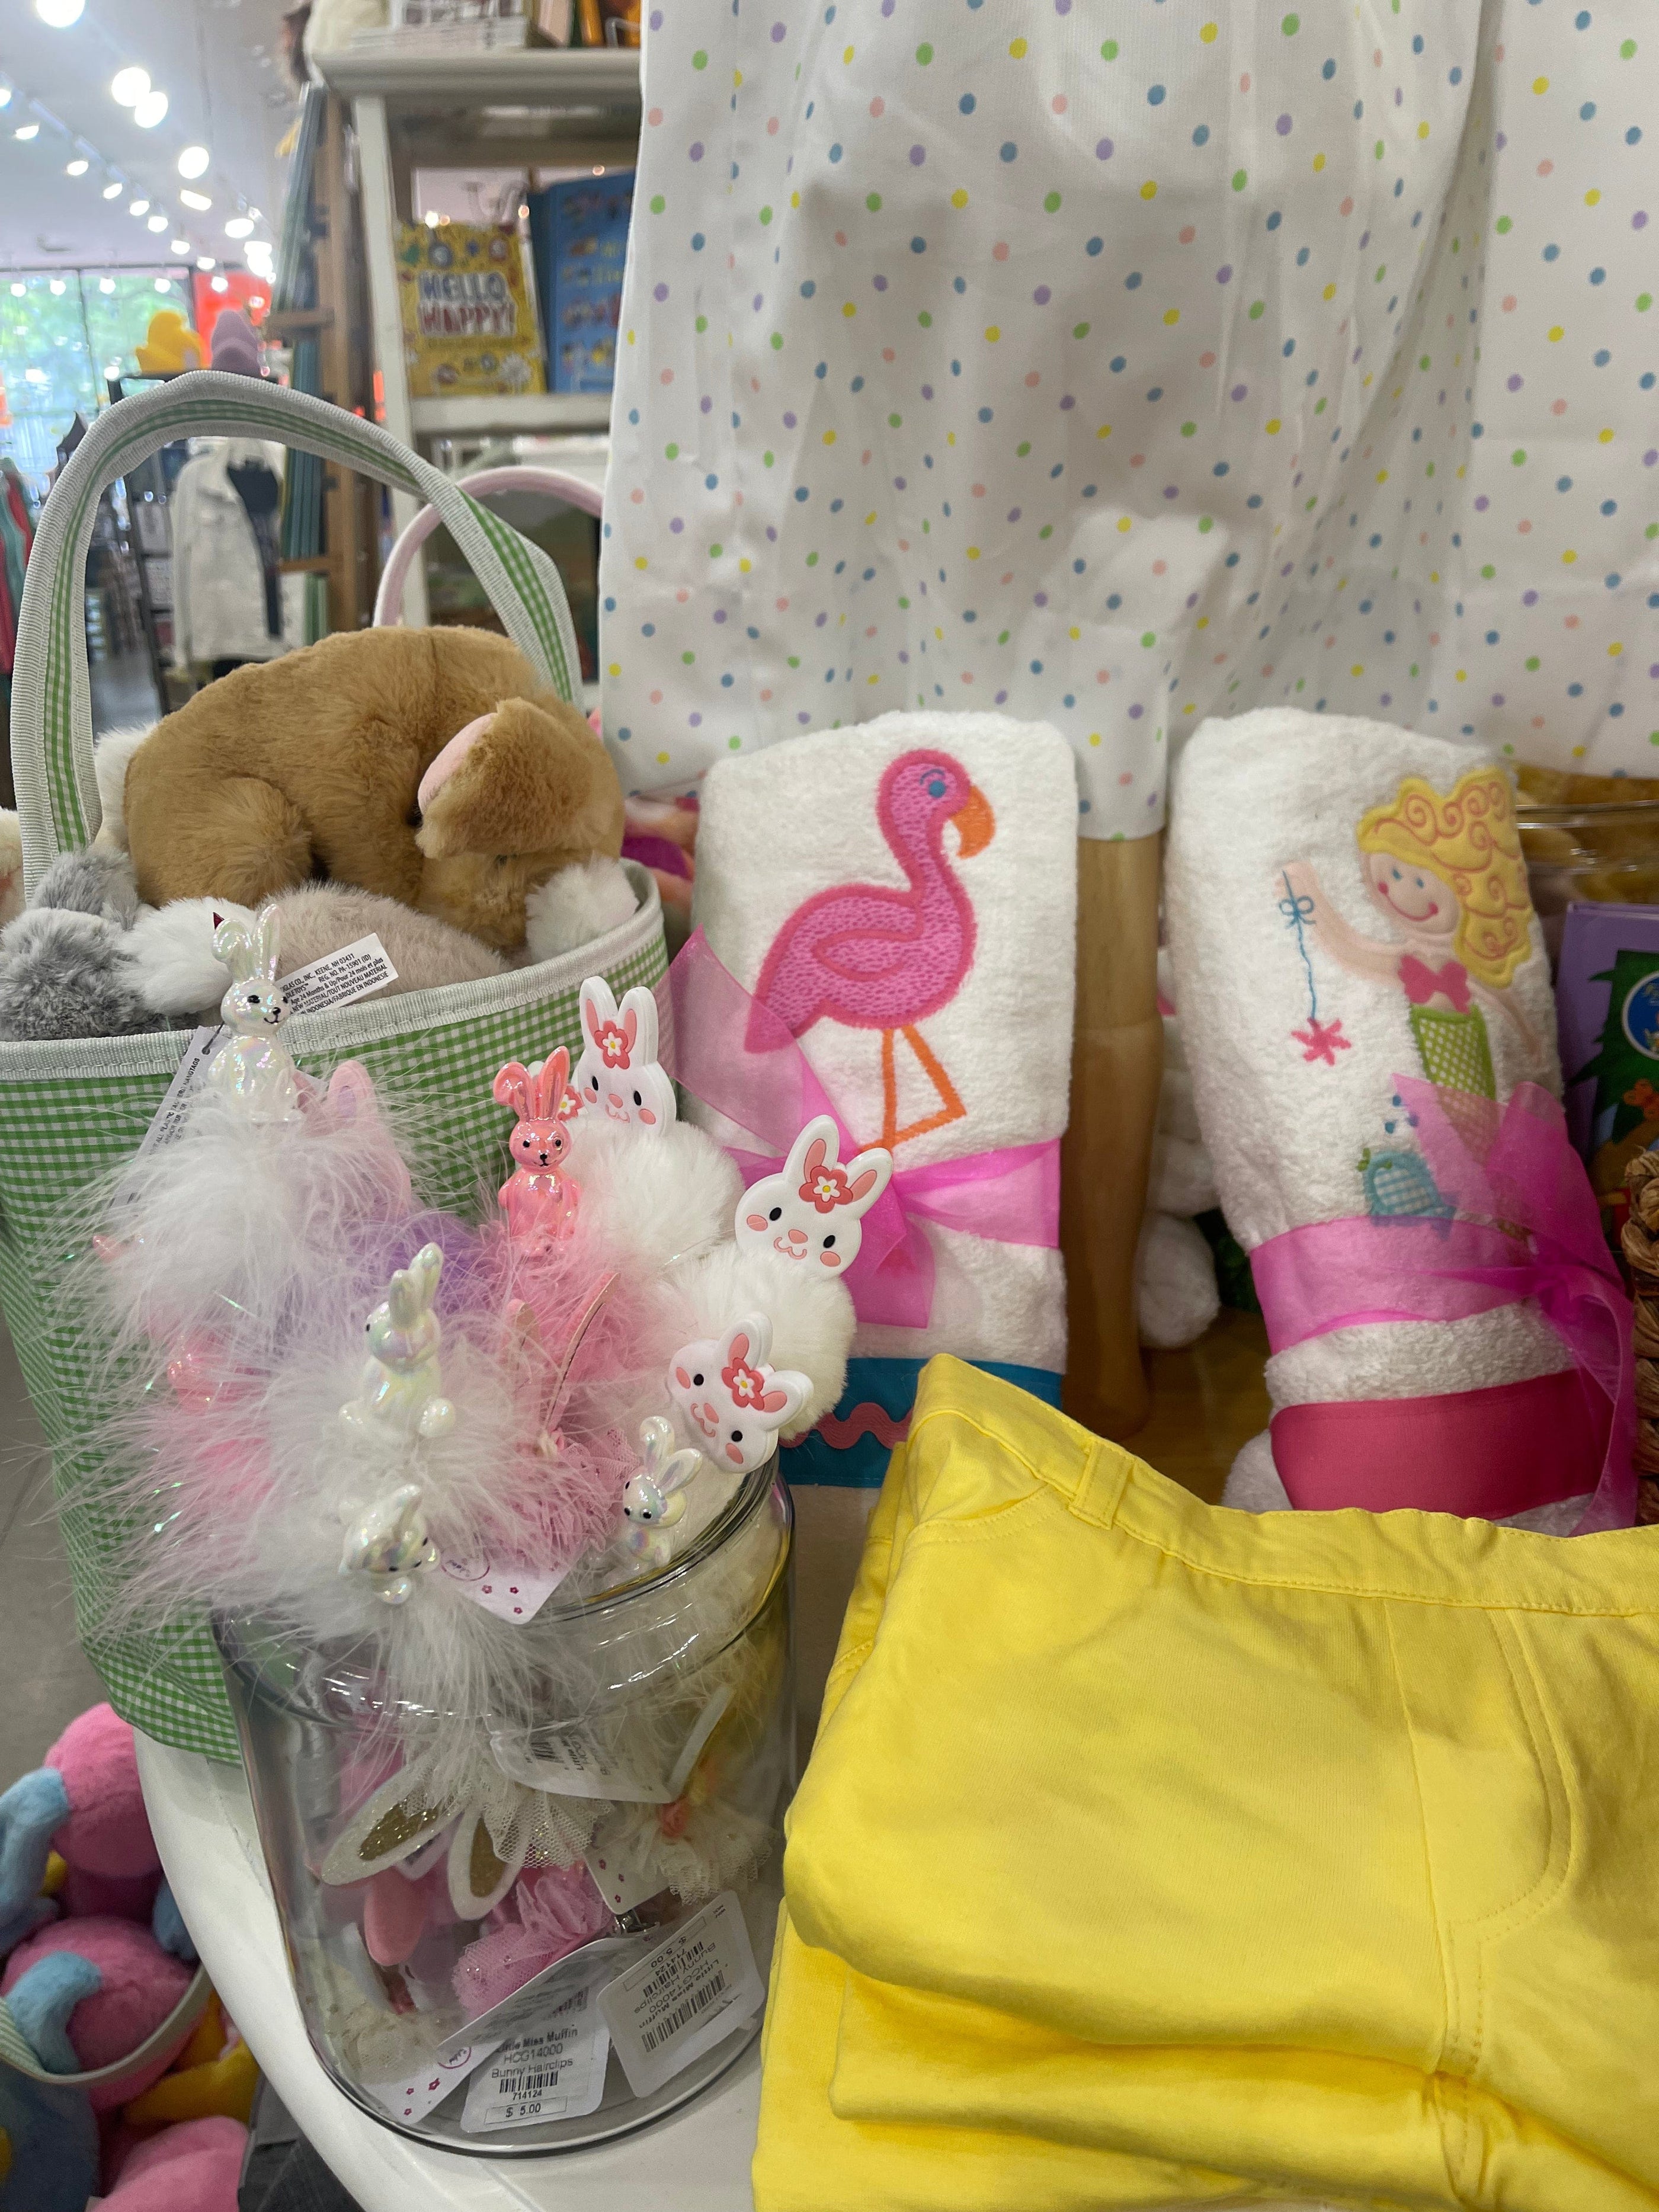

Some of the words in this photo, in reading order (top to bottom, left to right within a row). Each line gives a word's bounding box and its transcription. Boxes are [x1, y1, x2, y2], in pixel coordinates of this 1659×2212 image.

[419, 270, 505, 298] HELLO
[318, 972, 330, 982] REG.
[329, 969, 339, 978] NO.
[338, 958, 361, 974] PA-15901
[360, 953, 371, 963] (ID)
[331, 959, 340, 968] NH
[338, 952, 354, 964] 03431
[290, 996, 300, 1006] Age
[305, 984, 325, 997] Months
[328, 972, 350, 987] Up/Pour
[354, 964, 367, 974] mois
[371, 955, 384, 966] plus
[292, 1003, 305, 1013] NEW
[340, 974, 364, 990] NOUVEAU
[363, 962, 387, 978] MATERIAL
[306, 986, 357, 1015] INDONESIA/FABRIQUE
[356, 982, 364, 991] EN
[363, 971, 389, 988] INDONESIE
[649, 1947, 673, 1969] 5.00
[654, 1947, 686, 1977] 714124
[680, 1941, 716, 1975] Bunny
[694, 1958, 719, 1981] Little
[633, 1972, 681, 2016] Hairclips
[648, 1958, 709, 2015] HCG14000
[671, 1981, 694, 2003] Miss
[638, 2000, 670, 2031] Muffin
[522, 2035, 544, 2047] Miss
[546, 2027, 578, 2042] Muffin
[502, 2042, 564, 2064] HCG14000
[490, 2063, 526, 2080] Bunny
[528, 2057, 574, 2075] Hairclips
[511, 2088, 543, 2101] 714124
[504, 2106, 514, 2117] $
[518, 2102, 542, 2115] 5.00
